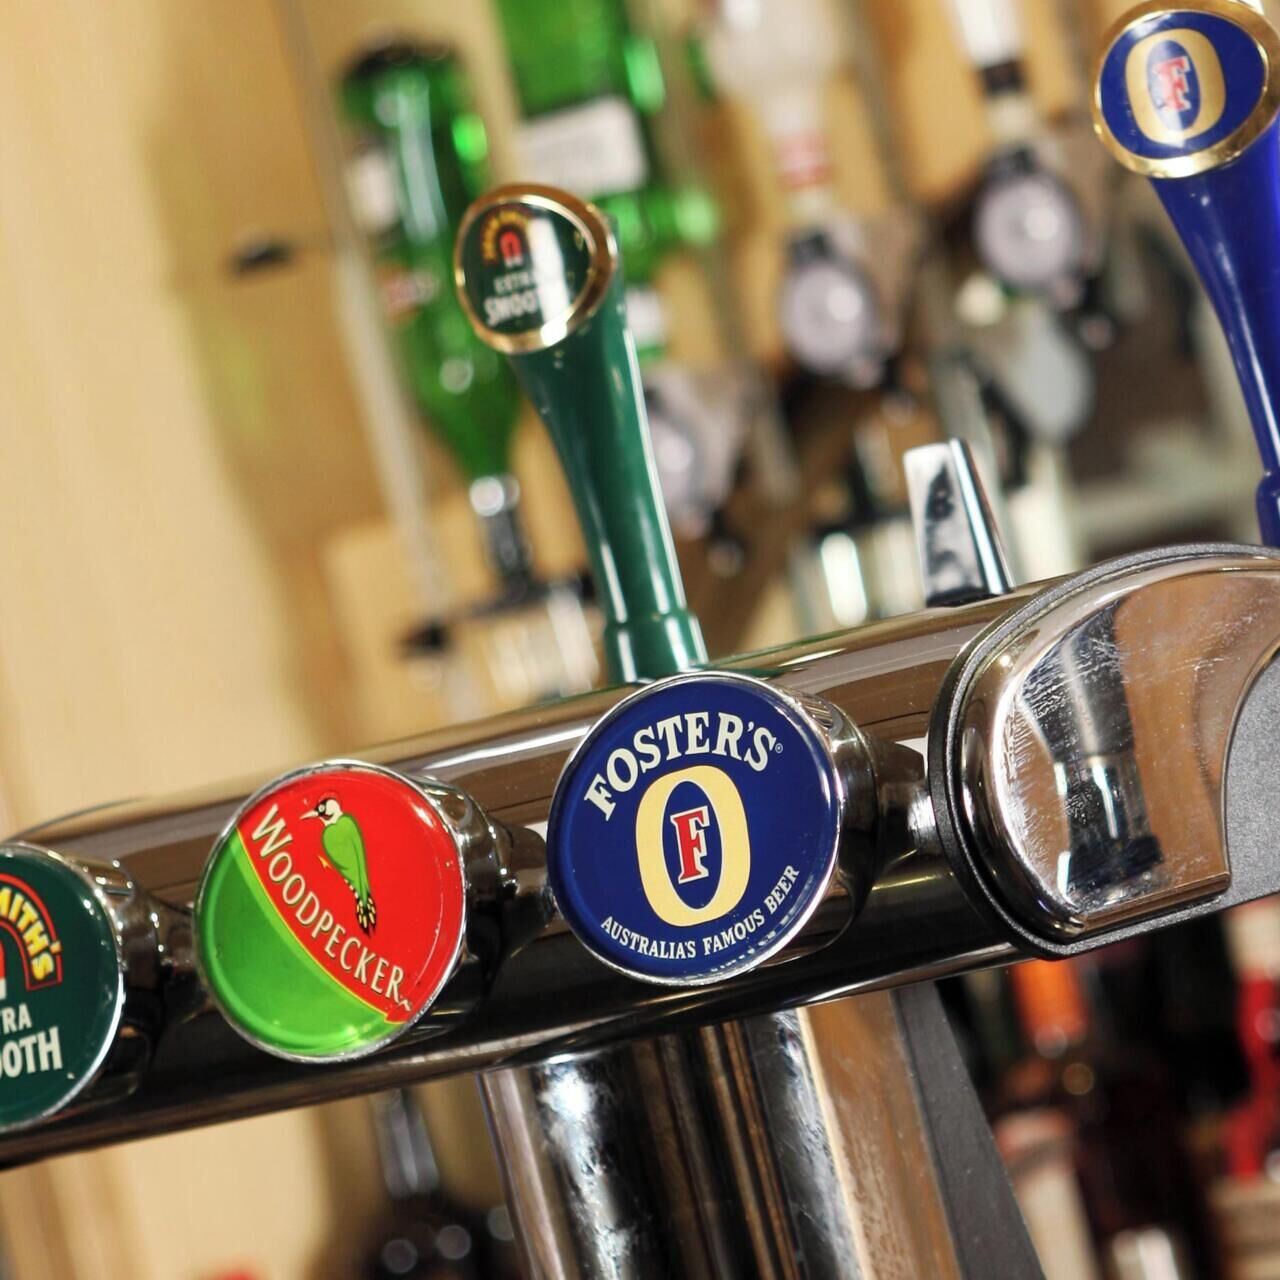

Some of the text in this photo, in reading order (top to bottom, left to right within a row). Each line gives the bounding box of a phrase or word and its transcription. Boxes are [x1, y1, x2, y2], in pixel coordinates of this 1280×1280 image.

[583, 710, 777, 822] FOSTER'S
[251, 803, 404, 1005] WOODPECKER
[600, 864, 800, 960] AUSTRALIA'S FAMOUS BEER
[0, 1026, 63, 1078] OTH
